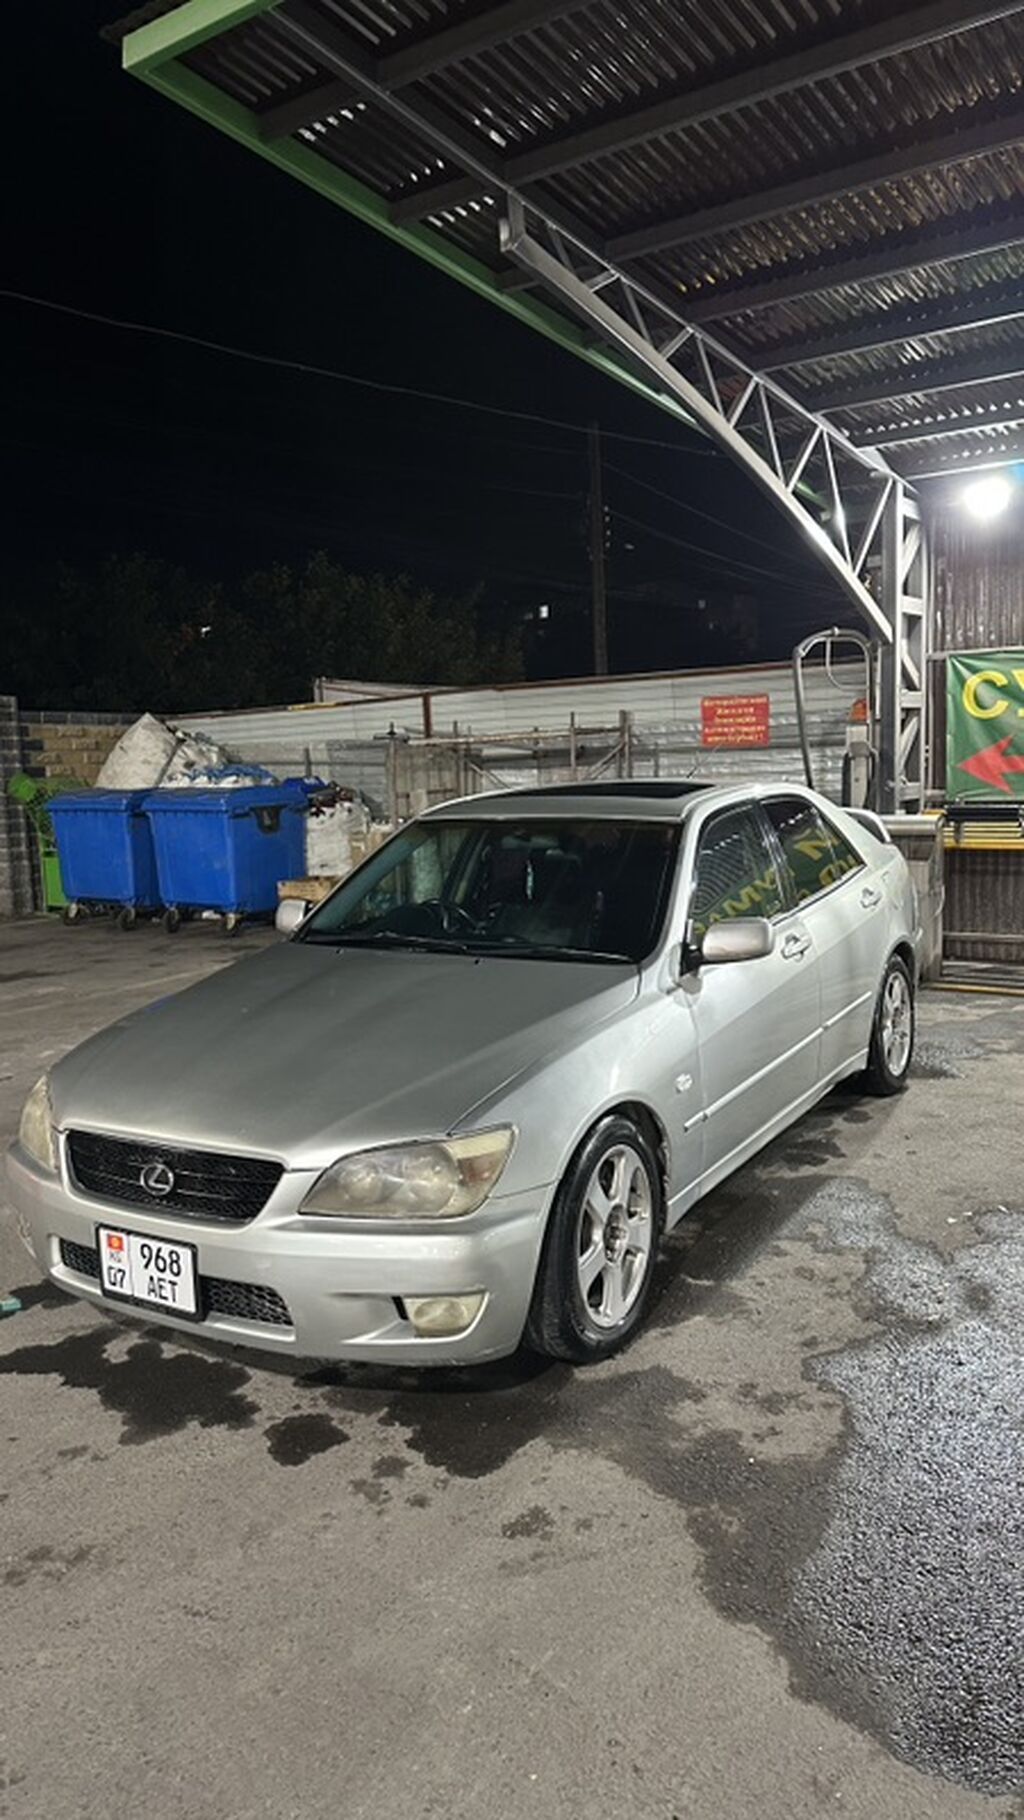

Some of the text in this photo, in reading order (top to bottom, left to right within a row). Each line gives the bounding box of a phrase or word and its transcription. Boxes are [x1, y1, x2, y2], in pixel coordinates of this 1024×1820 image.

[140, 1243, 183, 1278] 968
[107, 1265, 127, 1289] 07
[147, 1275, 179, 1303] AET
